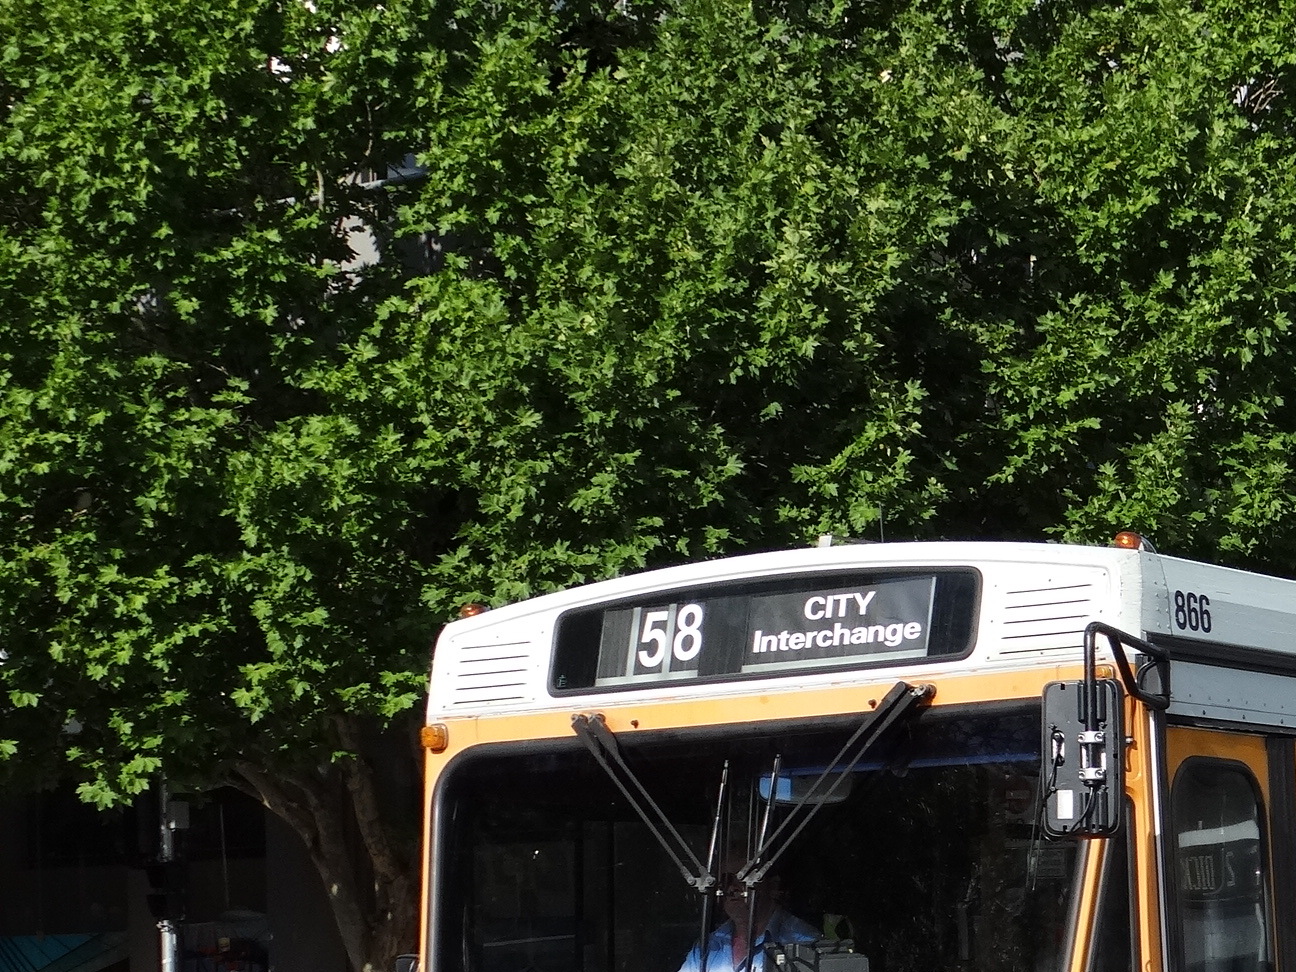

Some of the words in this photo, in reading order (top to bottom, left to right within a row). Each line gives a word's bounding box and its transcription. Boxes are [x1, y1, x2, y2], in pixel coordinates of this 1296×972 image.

[804, 591, 875, 620] CITY
[1174, 590, 1211, 634] 866
[638, 602, 702, 668] 58
[753, 619, 921, 654] Interchange
